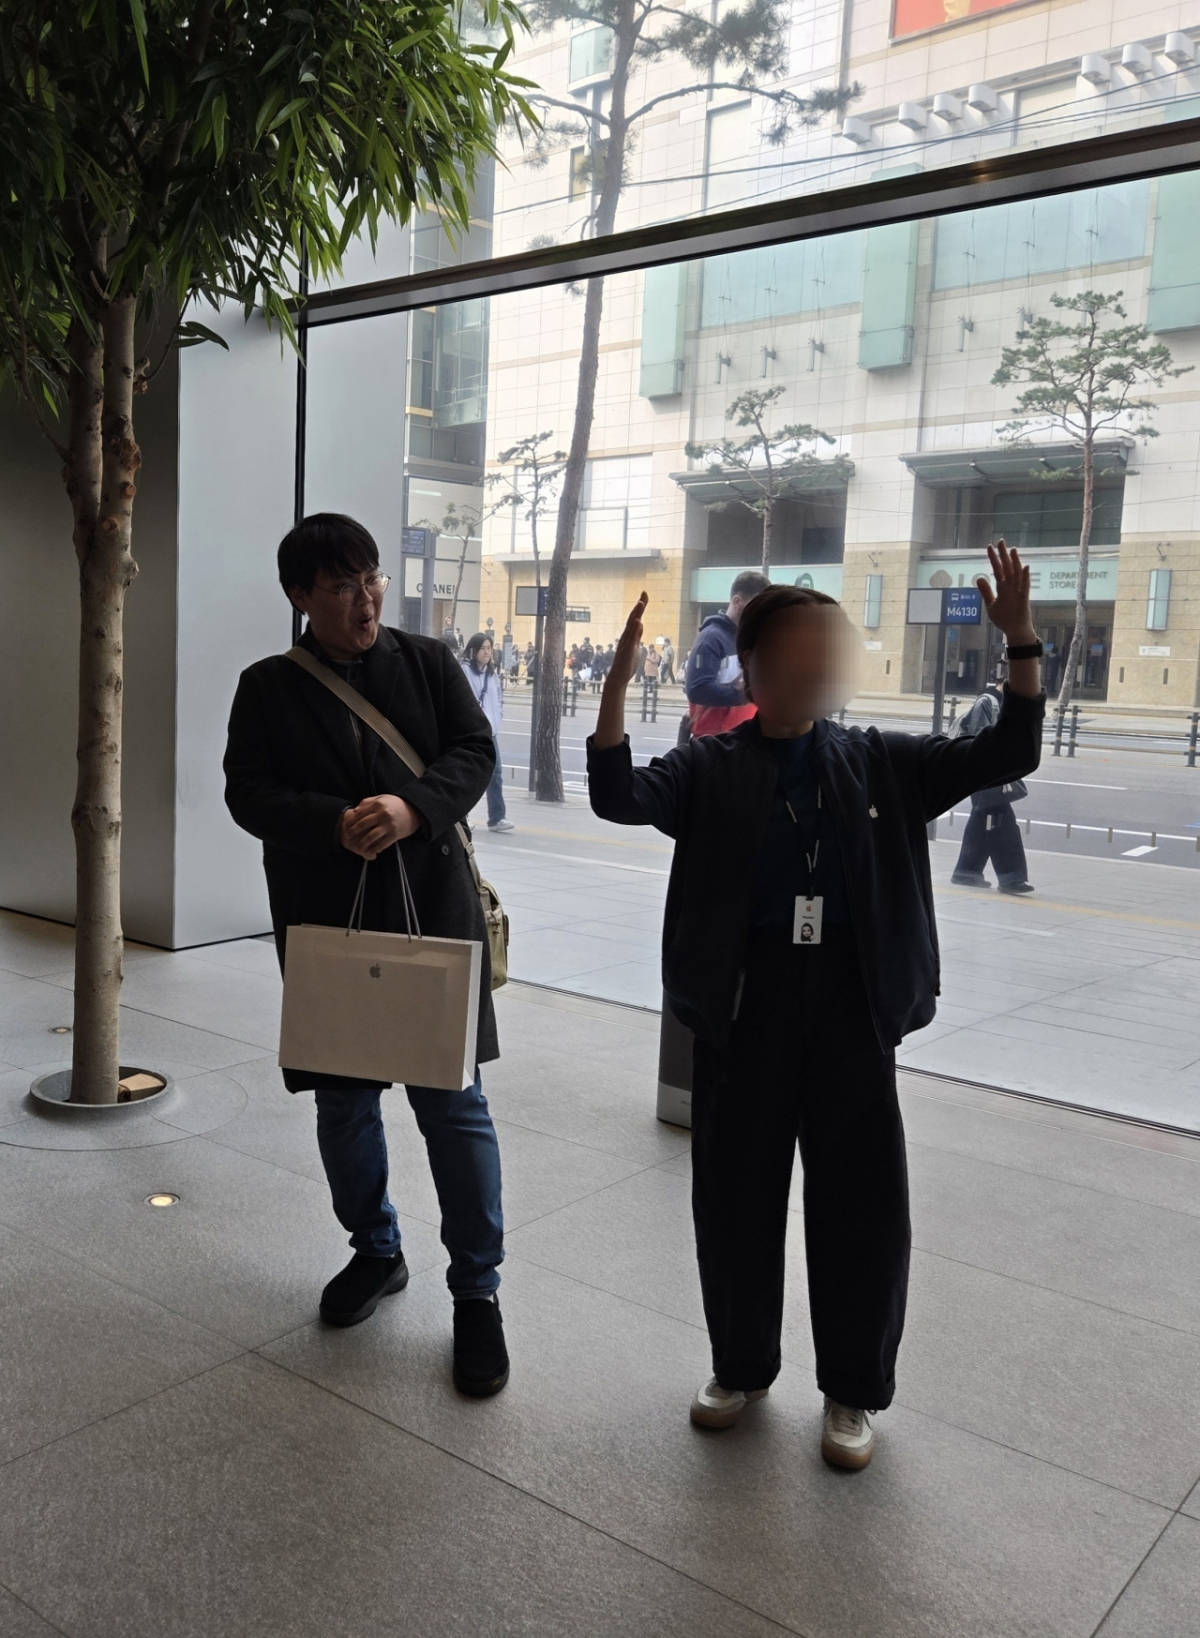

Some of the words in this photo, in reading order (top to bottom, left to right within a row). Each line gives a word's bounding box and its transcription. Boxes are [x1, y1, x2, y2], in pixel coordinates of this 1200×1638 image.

[1050, 571, 1108, 580] DEPARTENT
[416, 582, 455, 594] CANE
[1049, 580, 1076, 589] STORE
[947, 606, 977, 617] M4130
